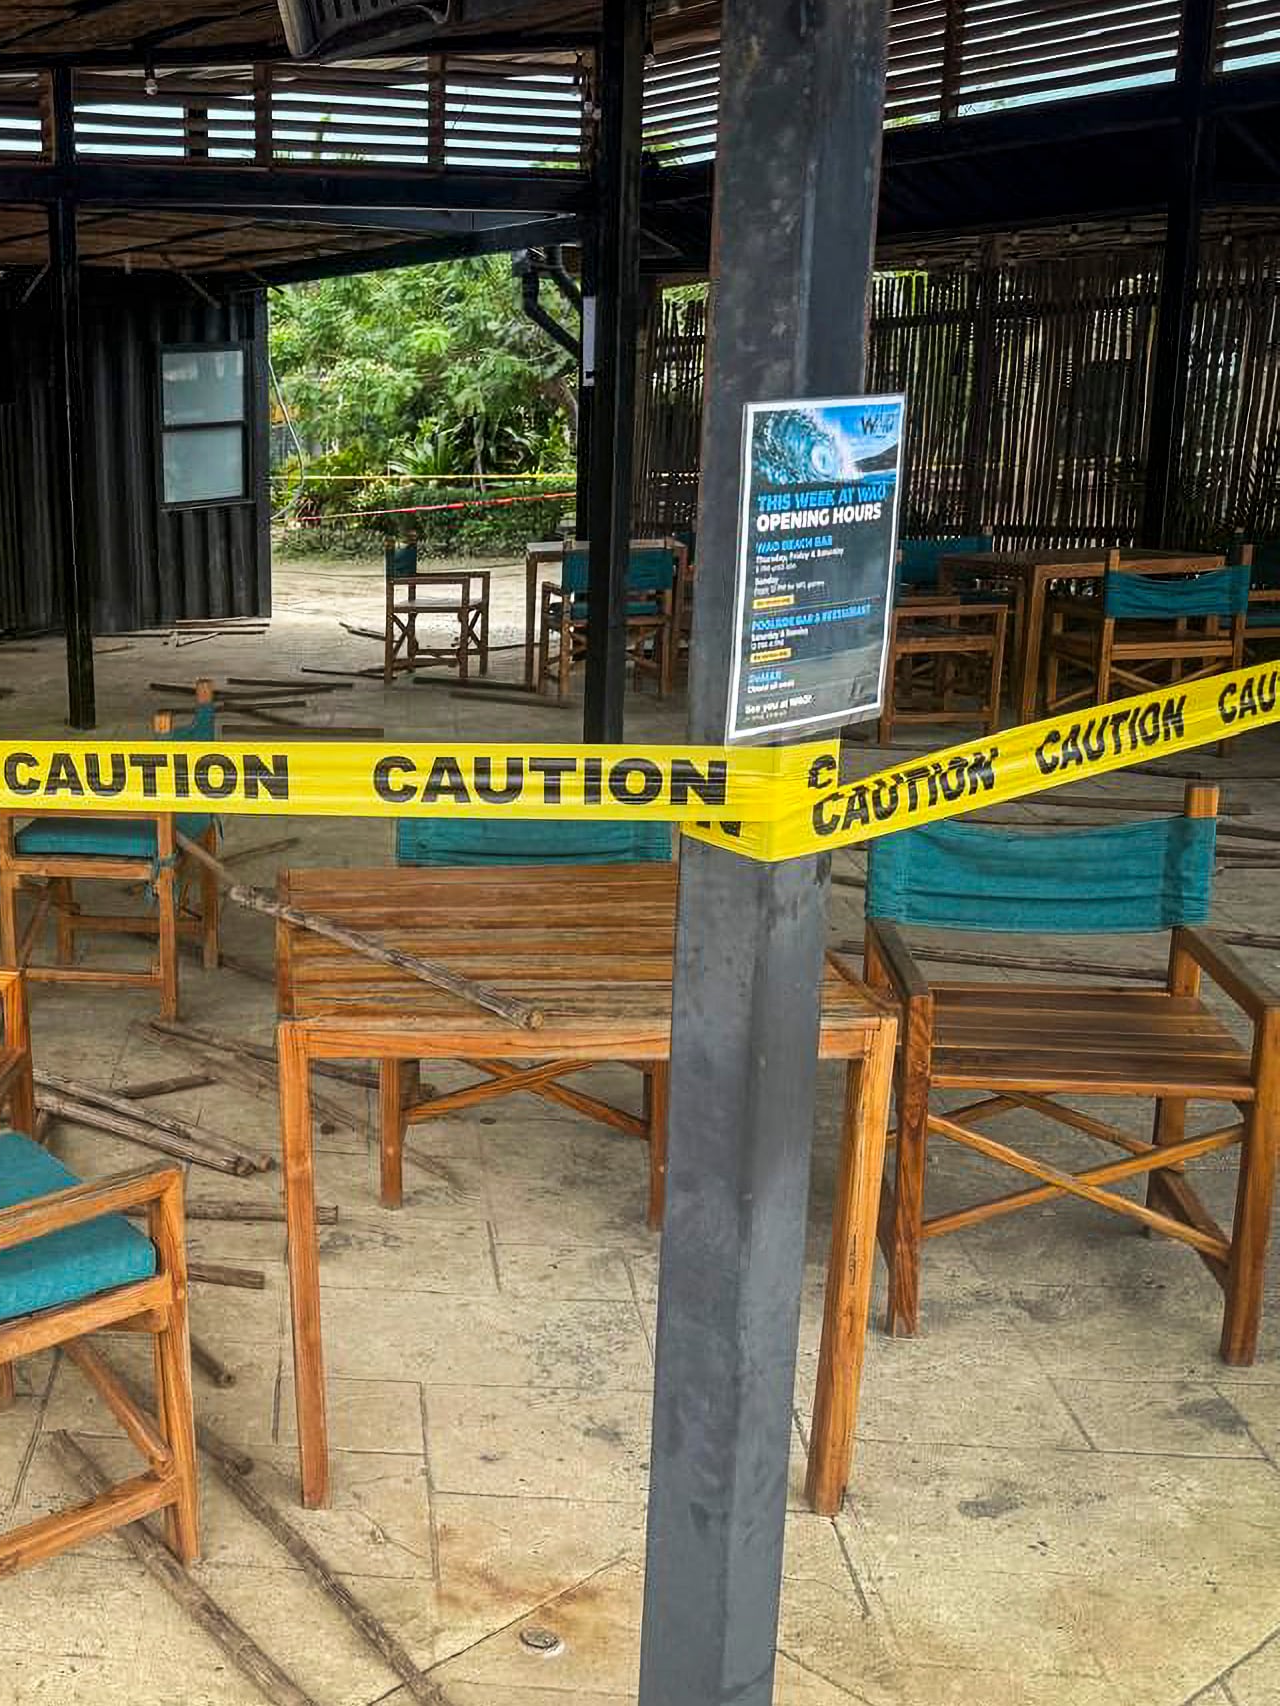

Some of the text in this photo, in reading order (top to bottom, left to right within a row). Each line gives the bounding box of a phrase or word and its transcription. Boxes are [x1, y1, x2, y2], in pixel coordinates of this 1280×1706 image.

[757, 492, 790, 511] THIS
[795, 489, 834, 508] WEEK
[838, 486, 853, 505] AT
[756, 503, 882, 532] OPENING HOURS
[781, 538, 813, 551] BEACH
[814, 535, 833, 547] BAR
[789, 550, 809, 561] Friday
[745, 703, 761, 715] See
[812, 671, 1280, 836] CAUTION CAUTION CAU
[3, 752, 289, 799] CAUTION
[373, 755, 728, 806] CAUTION
